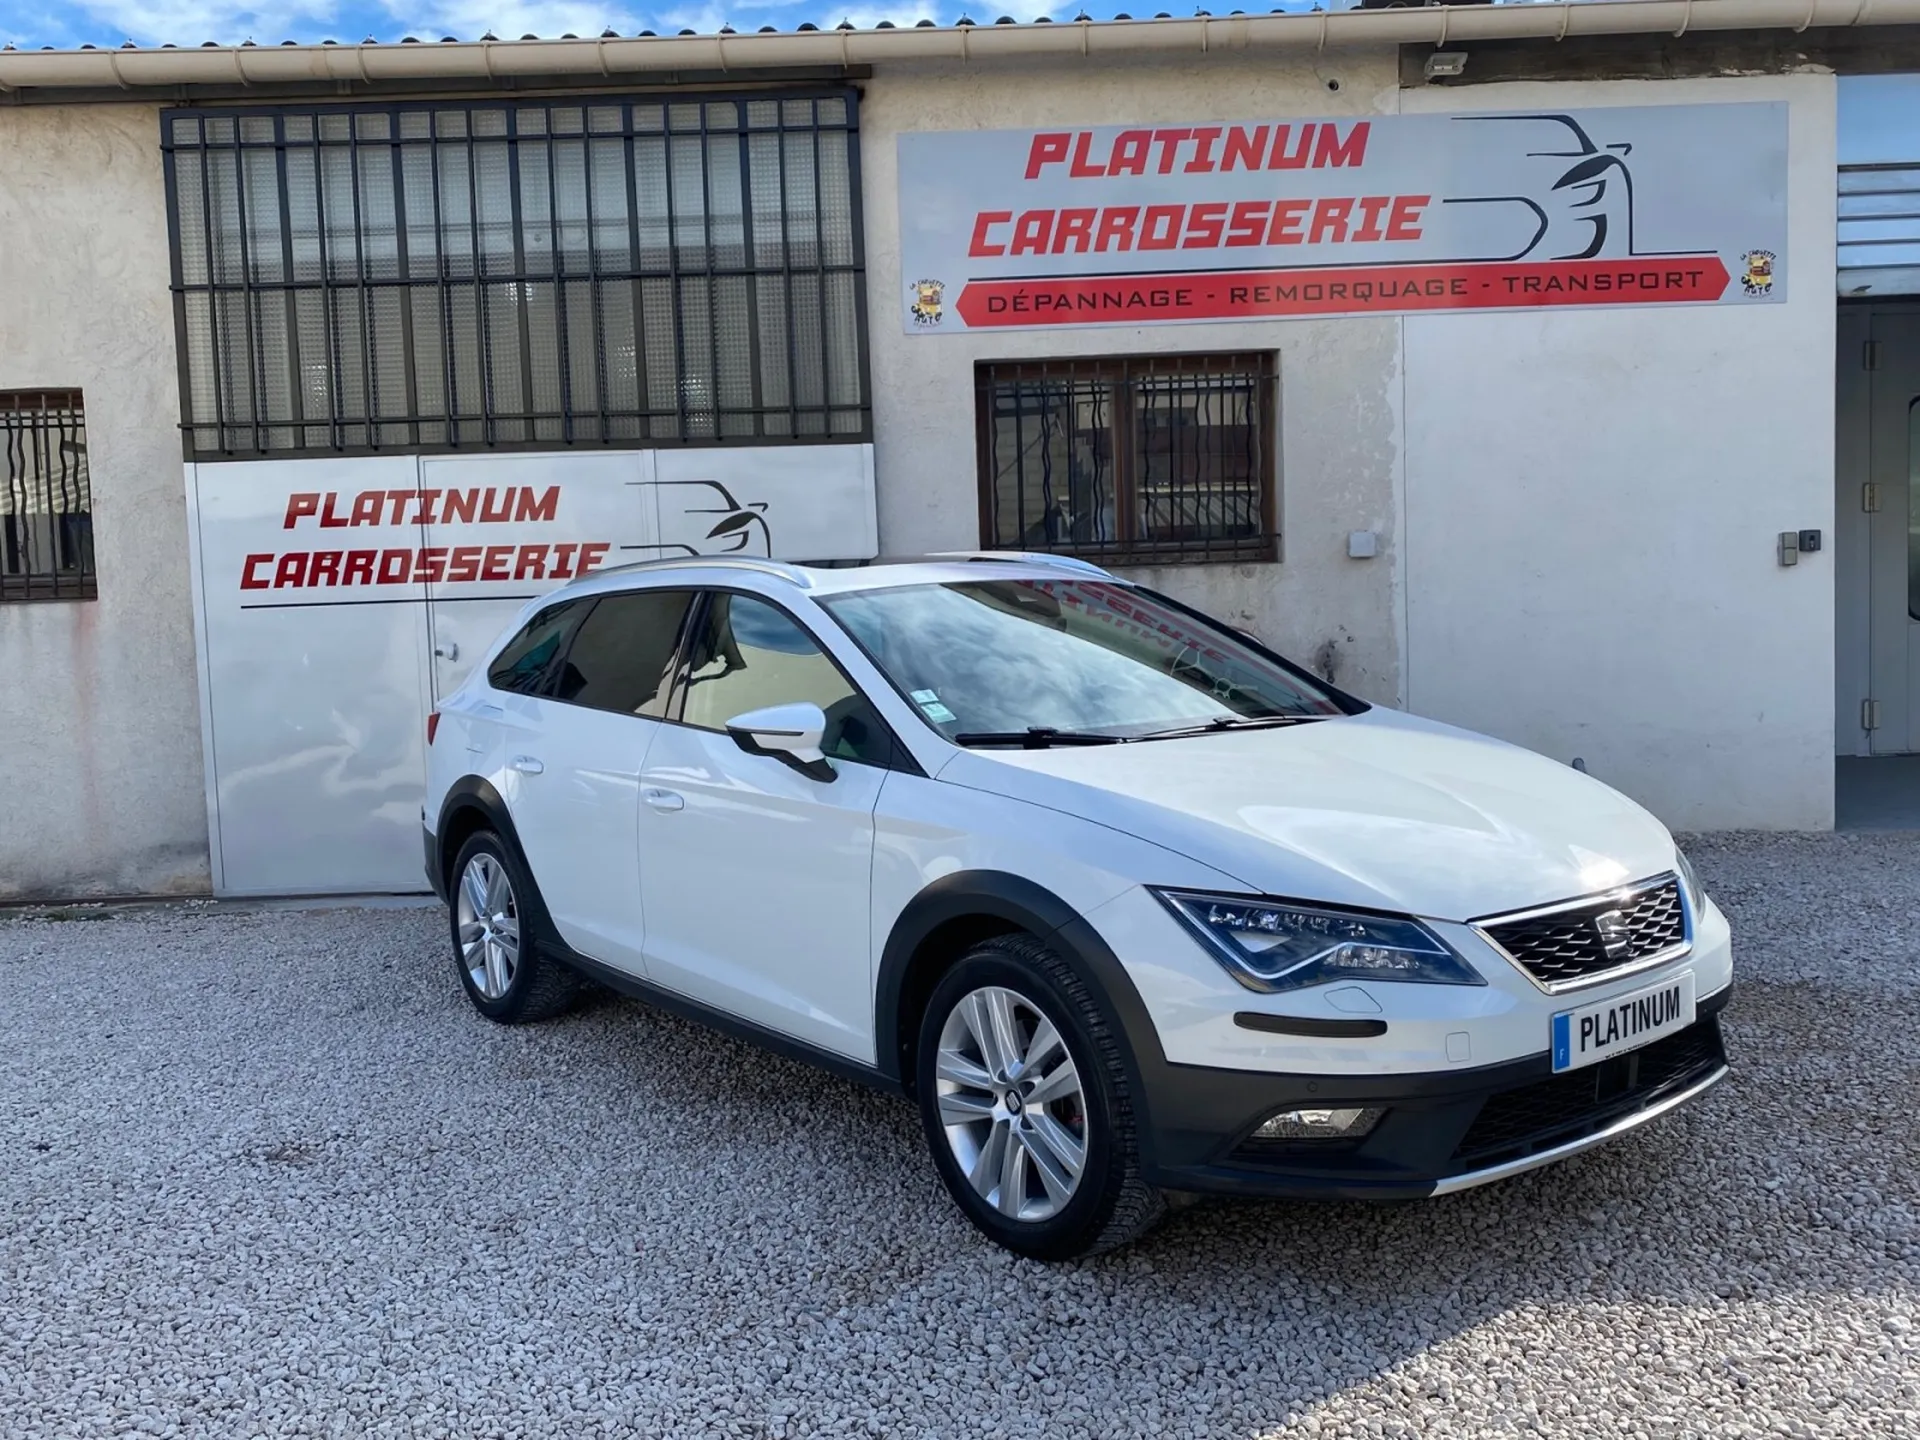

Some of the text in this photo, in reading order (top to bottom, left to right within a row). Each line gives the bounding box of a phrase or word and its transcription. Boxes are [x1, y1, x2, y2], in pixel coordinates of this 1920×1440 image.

[1024, 121, 1371, 179] PLATINUM
[968, 195, 1431, 257] CARROSSERIE
[988, 289, 1193, 313] DÉPANNAGE
[1230, 278, 1468, 304] REMORQUAGE
[1502, 271, 1704, 293] TRANSPORT
[283, 485, 561, 529] PLATINUM
[240, 542, 611, 590] CARROSSERIE
[1580, 986, 1680, 1052] PLATINUM
